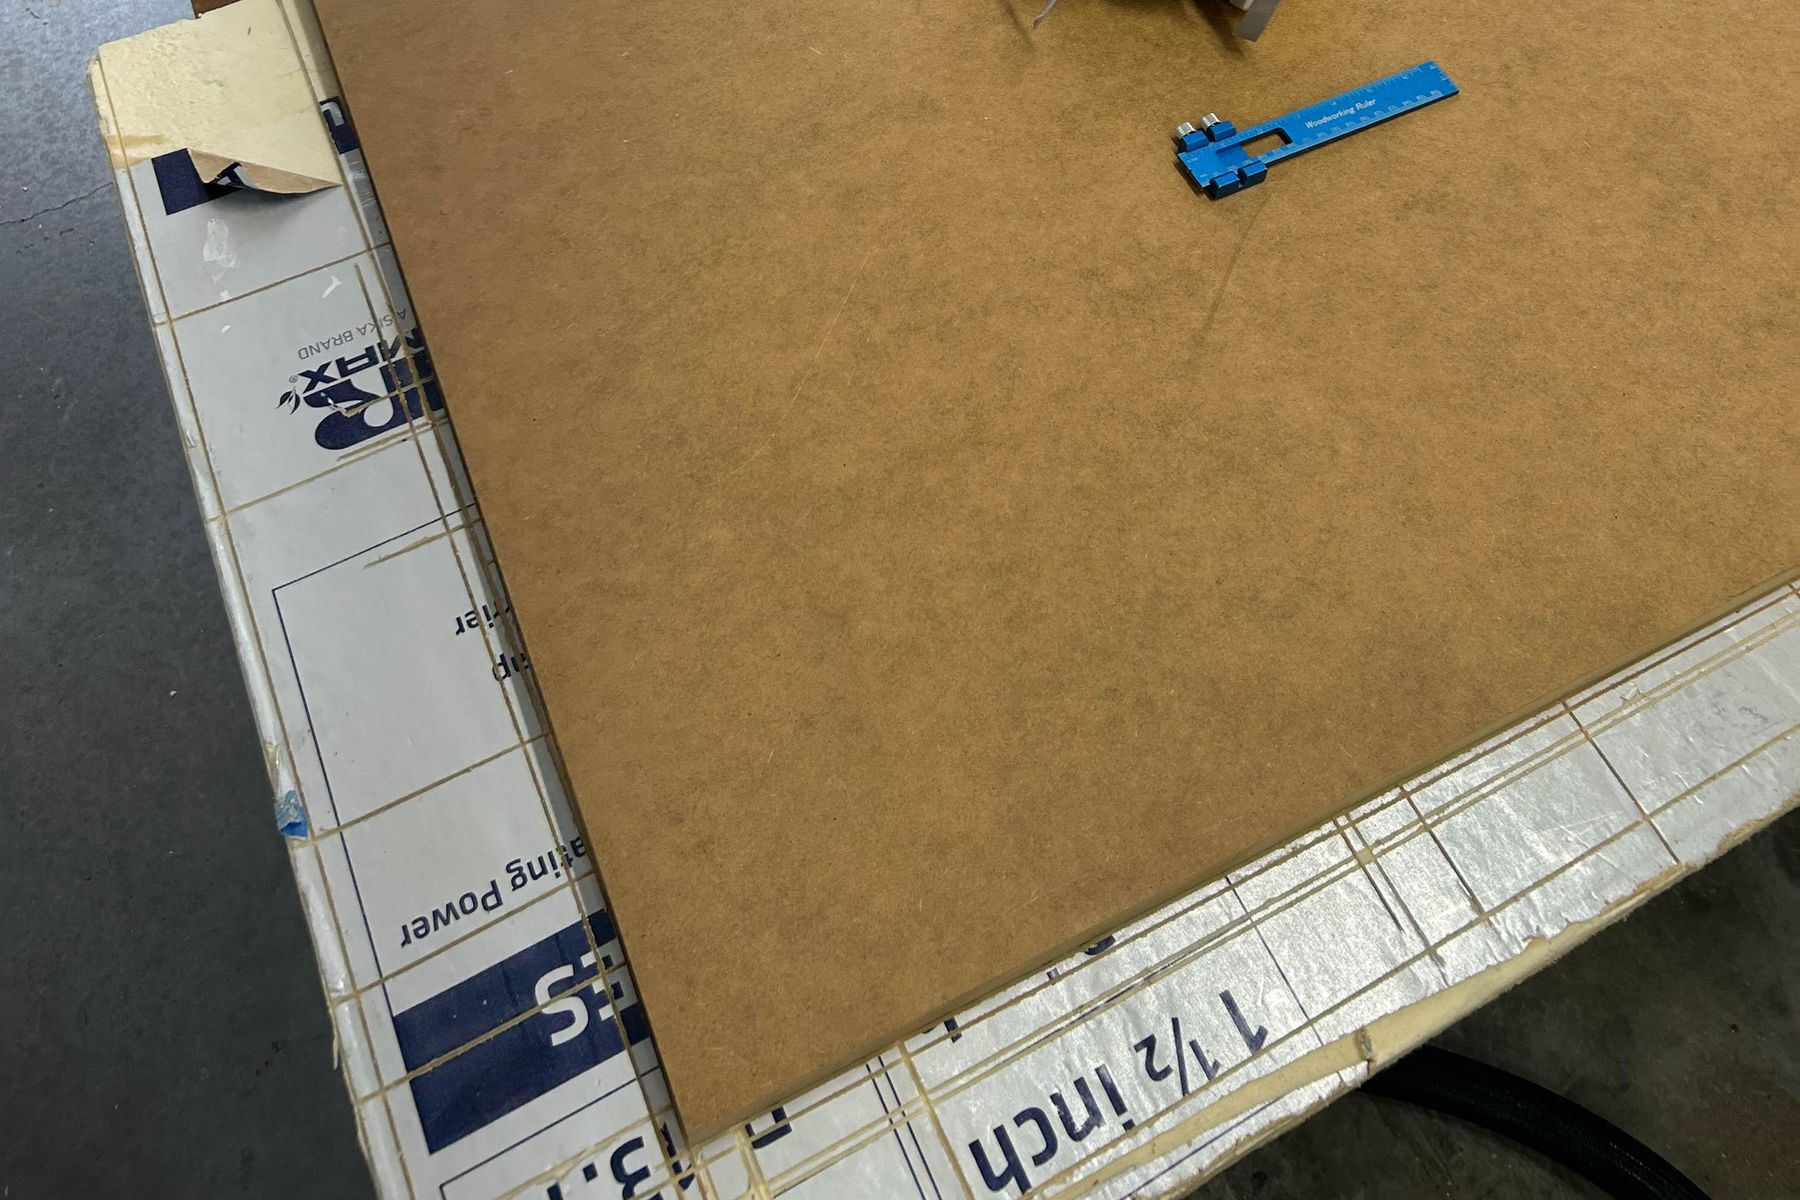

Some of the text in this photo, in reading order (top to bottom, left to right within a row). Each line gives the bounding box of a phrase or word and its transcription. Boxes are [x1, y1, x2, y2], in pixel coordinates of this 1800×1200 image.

[1304, 105, 1356, 130] Woodworking
[1355, 98, 1377, 112] Ruler
[297, 329, 354, 361] BRAND
[400, 879, 504, 949] Power
[968, 1063, 1136, 1195] inch
